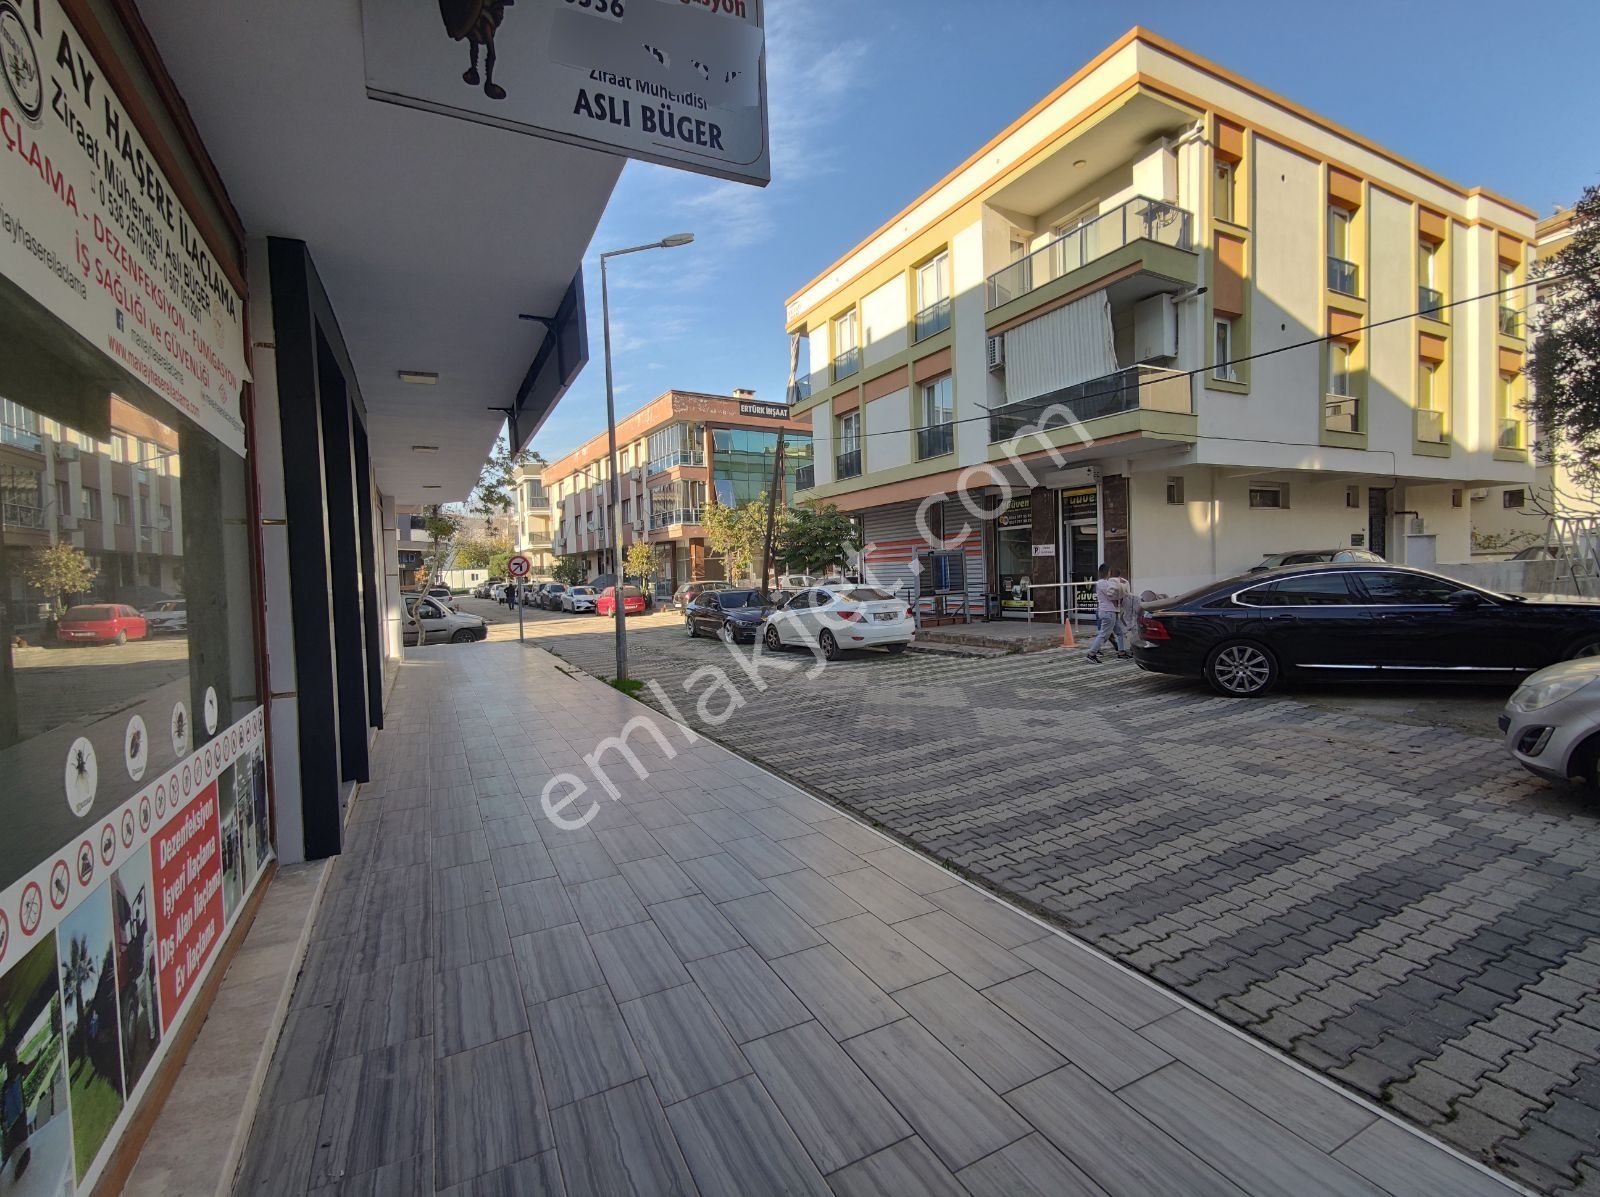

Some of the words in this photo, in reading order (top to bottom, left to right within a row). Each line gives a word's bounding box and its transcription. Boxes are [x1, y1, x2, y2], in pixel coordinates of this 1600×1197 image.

[573, 88, 631, 128] ASLI
[640, 103, 726, 151] BÜGER
[51, 76, 100, 170] Ziraat
[104, 149, 163, 252] Mühendisi
[165, 239, 182, 279] Aslı
[184, 262, 211, 317] BÜGER
[56, 30, 95, 110] AY
[104, 95, 175, 232] HAŞERE
[179, 208, 237, 324] İLAÇLAMA
[100, 180, 105, 206] 0
[108, 191, 124, 230] 536
[0, 107, 78, 217] ÇLAMA
[93, 212, 186, 337] DEZENFEKSİYON
[192, 329, 237, 391] FUMİGASYON
[75, 228, 91, 278] İŞ
[95, 257, 147, 329] SAĞLIĞI
[150, 318, 161, 343] ve
[164, 330, 210, 388] GÜVENLİĞİ
[740, 404, 765, 415] ERTÜRK
[160, 797, 214, 870] Dezenfeksiyon
[162, 863, 186, 919] İşyeri
[186, 835, 216, 886] İlaçlama
[160, 932, 175, 971] Dış
[176, 906, 193, 949] Alan
[193, 868, 221, 921] İlaçlama
[175, 962, 185, 997] Ev
[186, 917, 215, 978] İlaçlama
